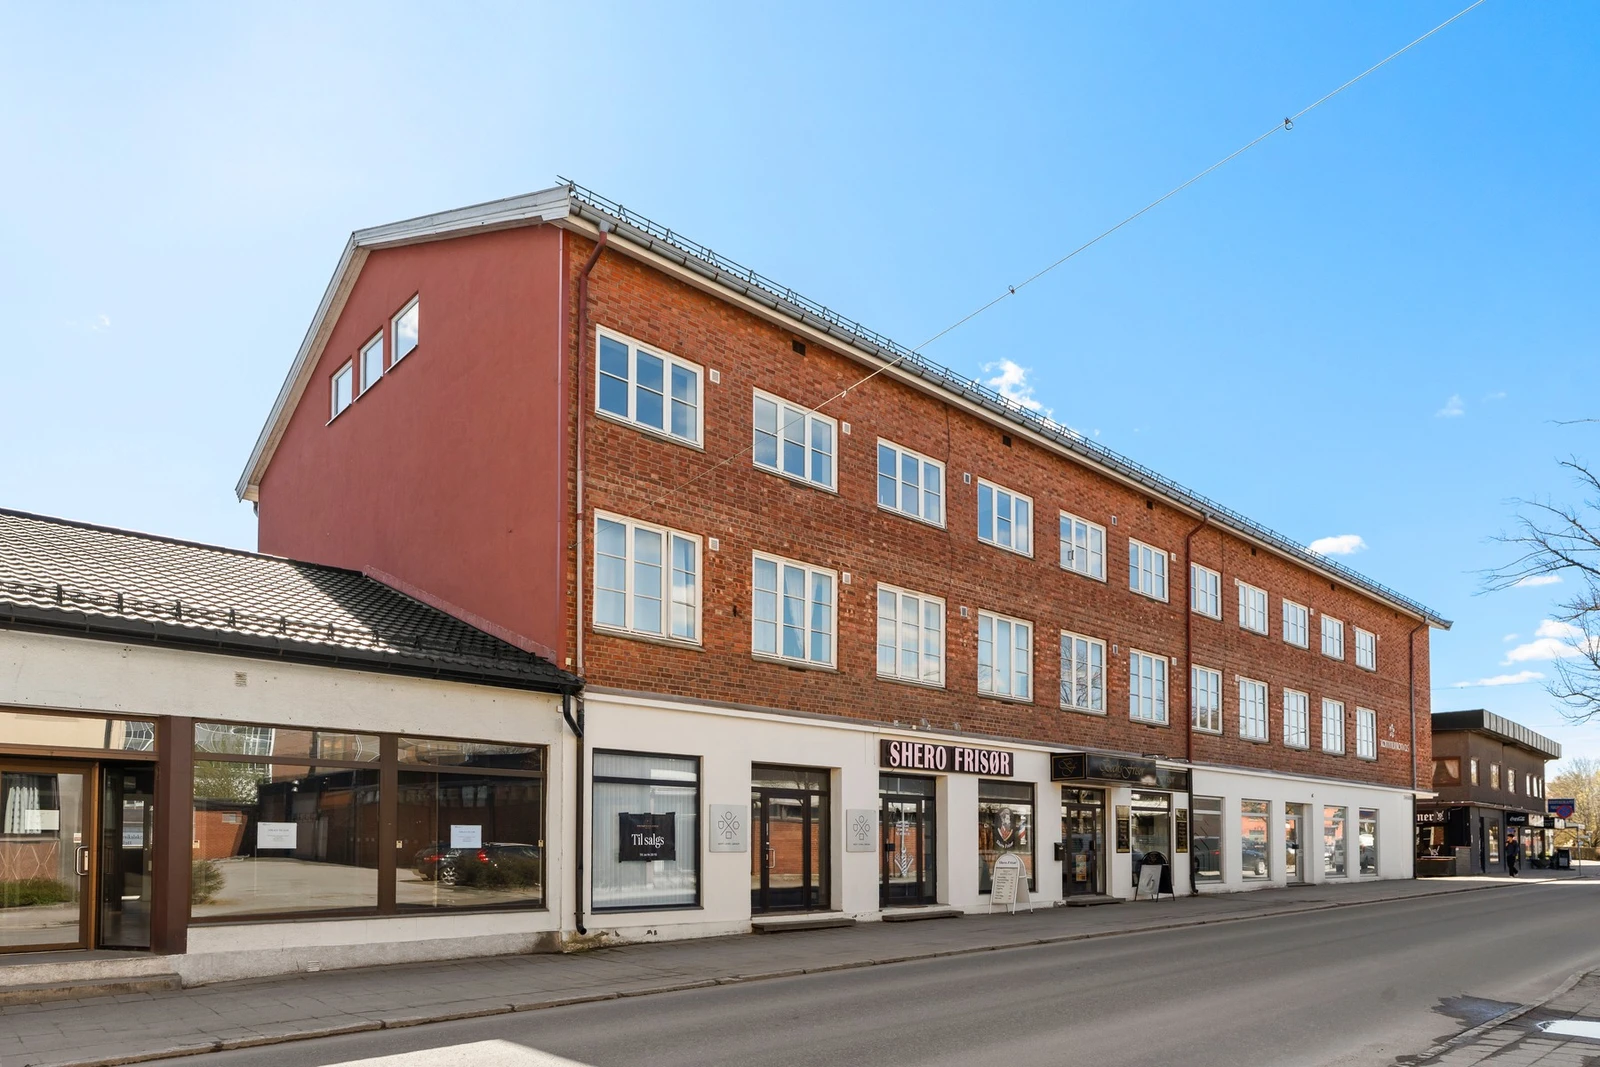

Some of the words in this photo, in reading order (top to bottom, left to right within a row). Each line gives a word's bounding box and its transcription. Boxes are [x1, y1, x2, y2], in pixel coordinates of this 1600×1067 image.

[889, 741, 947, 770] SHERO
[954, 747, 1010, 775] FRISØR
[631, 833, 643, 846] Til
[644, 833, 665, 849] salgs
